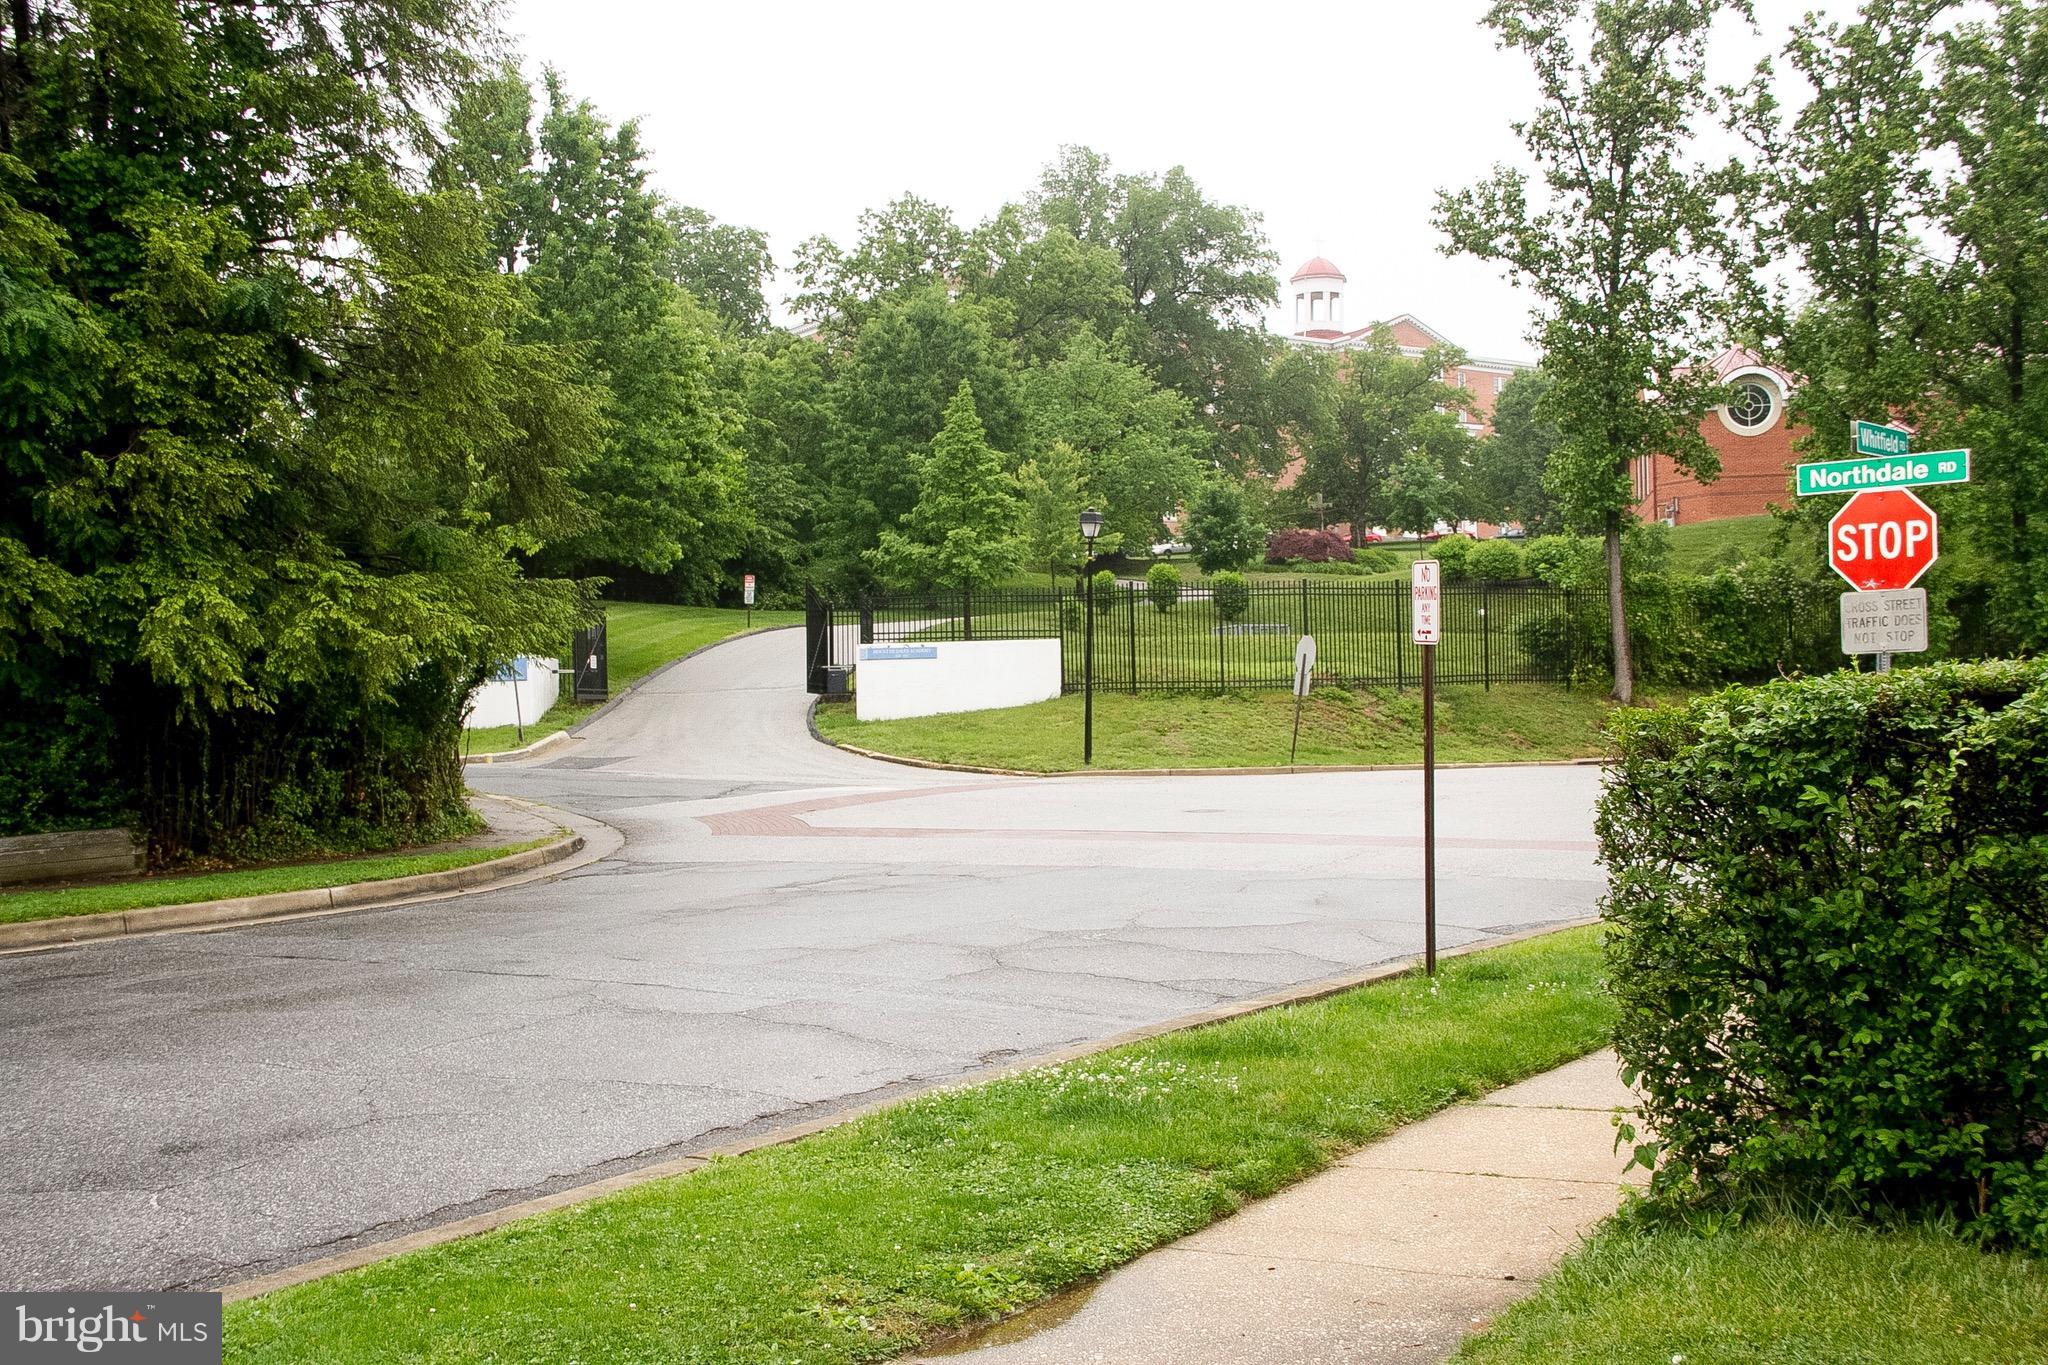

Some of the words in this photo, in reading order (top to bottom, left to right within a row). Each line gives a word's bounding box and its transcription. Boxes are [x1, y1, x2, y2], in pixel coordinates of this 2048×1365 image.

[1861, 427, 1898, 453] Whitfield
[1810, 460, 1929, 488] Northdale
[1938, 461, 1957, 474] RD
[1837, 520, 1928, 561] STOP
[1421, 567, 1431, 582] NO
[1415, 586, 1437, 601] PARKING
[1421, 603, 1431, 612] ANY
[1883, 598, 1922, 611] STREET
[1421, 615, 1431, 625] TIME
[1846, 616, 1889, 628] TRAFFIC
[1894, 614, 1922, 626] DOES
[1854, 632, 1876, 644] NOT
[1886, 630, 1915, 642] STOP
